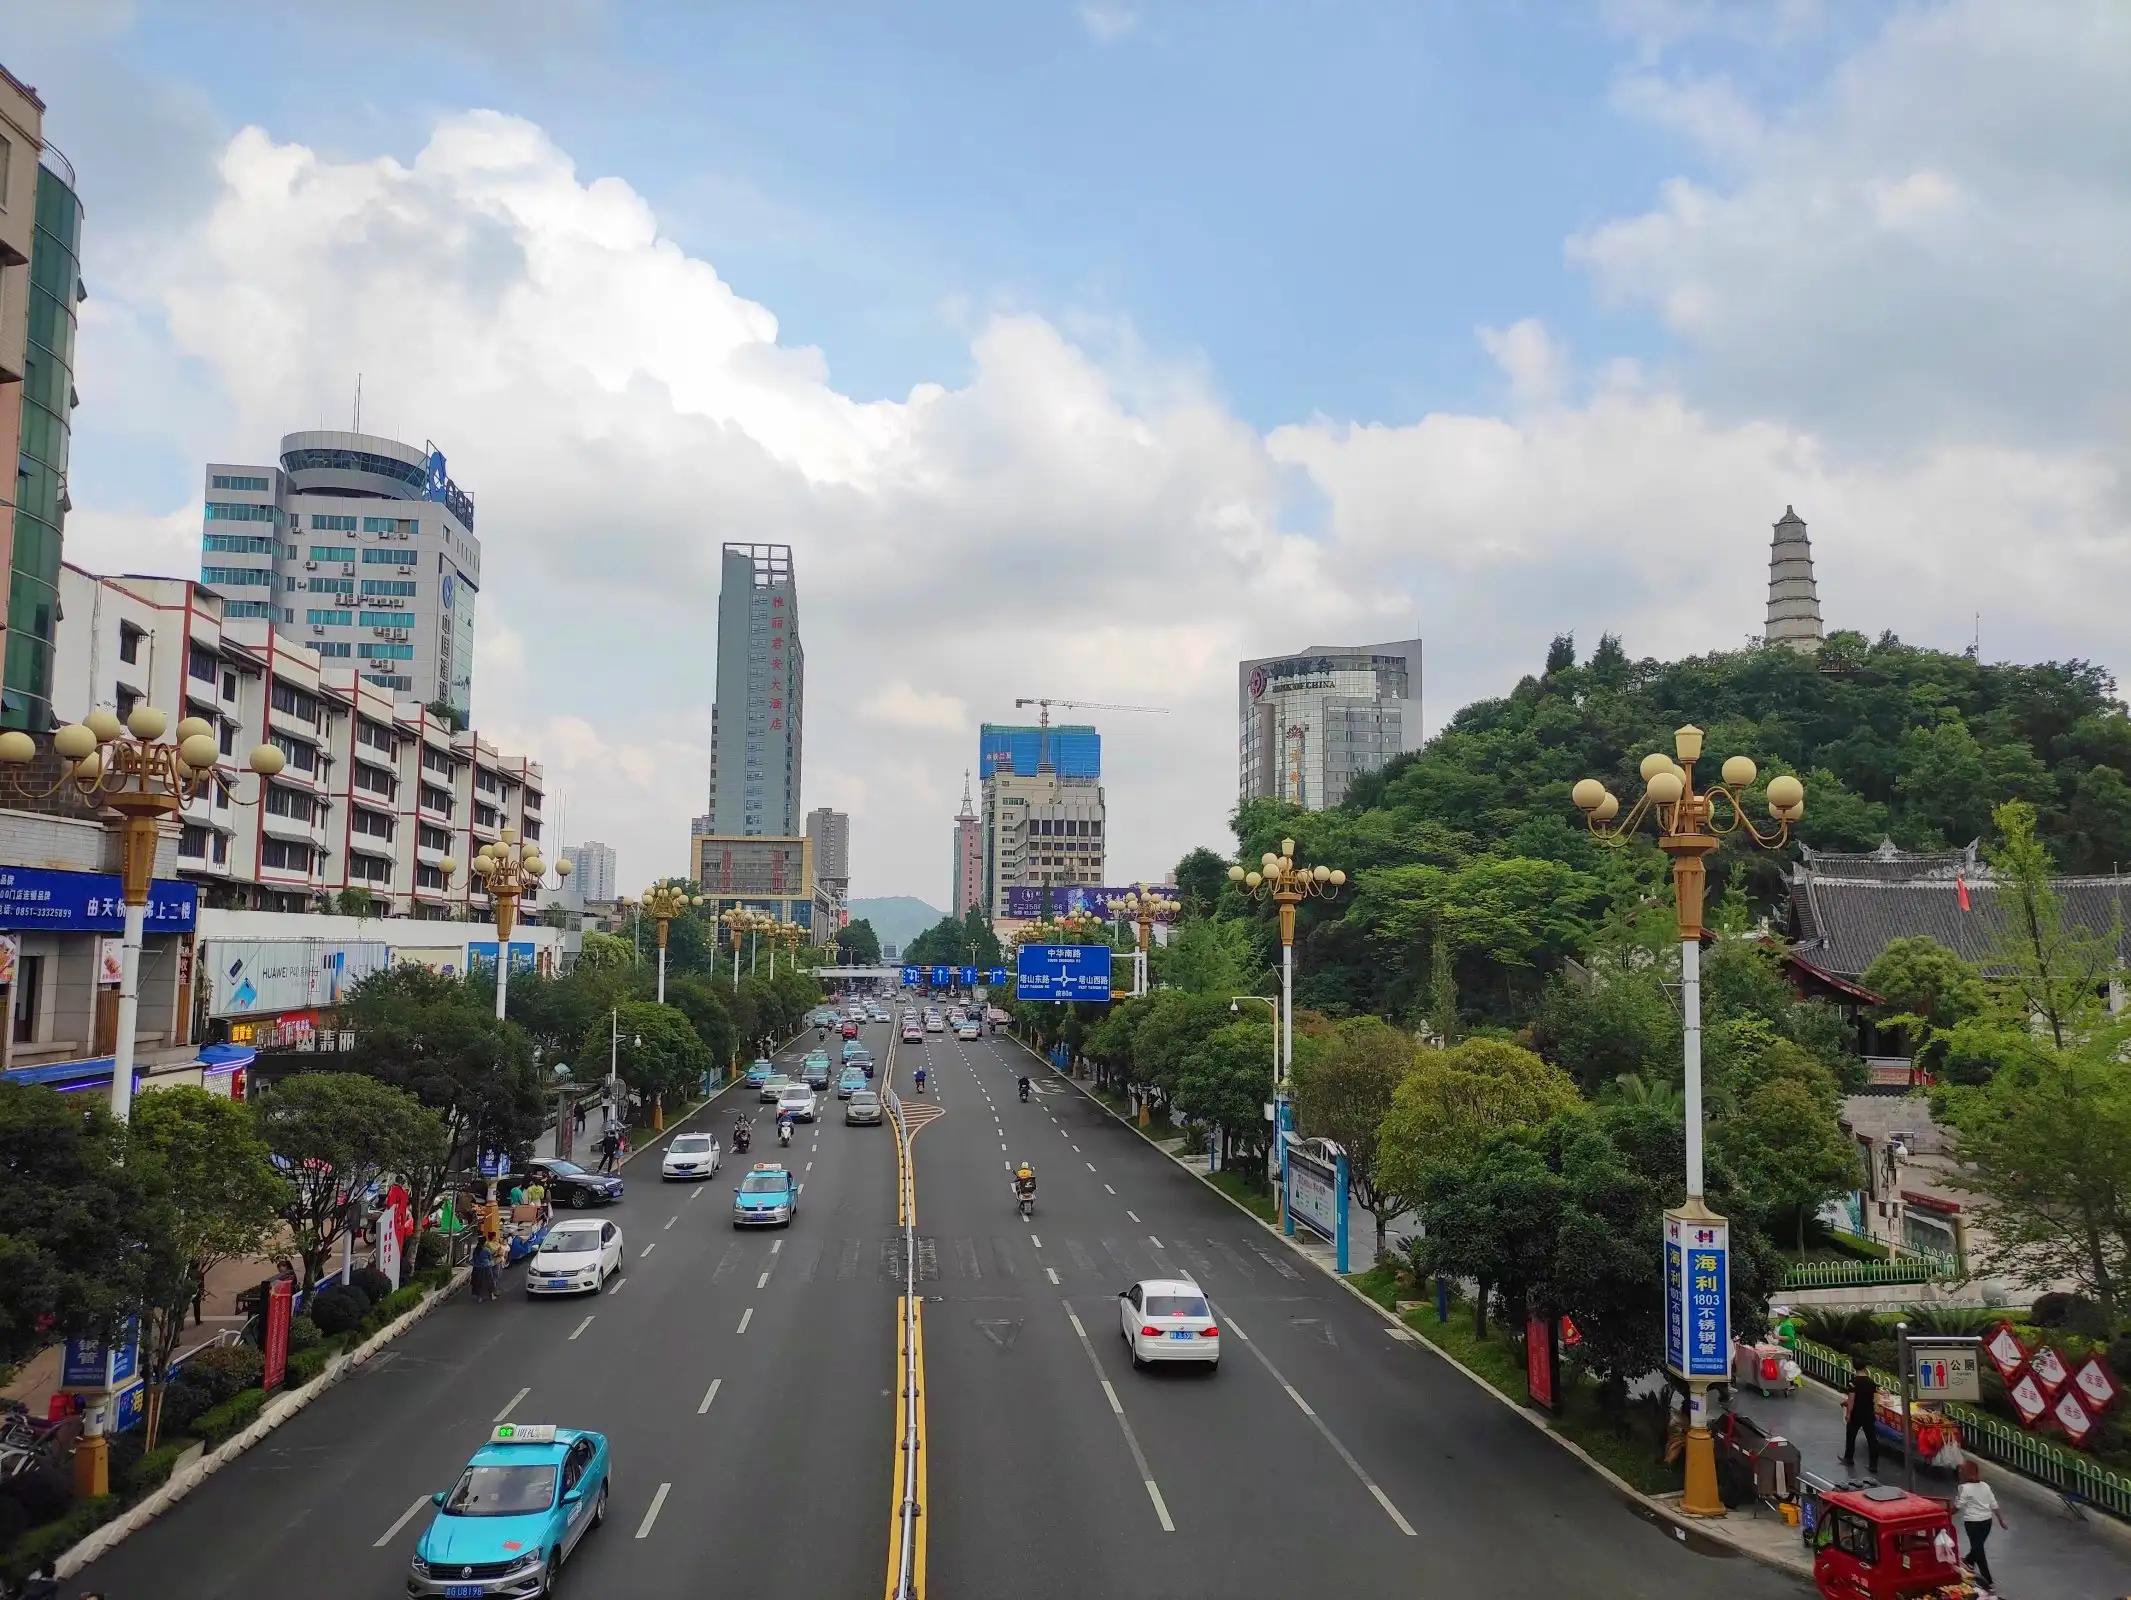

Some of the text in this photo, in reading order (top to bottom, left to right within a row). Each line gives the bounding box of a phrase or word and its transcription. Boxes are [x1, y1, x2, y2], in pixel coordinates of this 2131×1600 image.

[1305, 681, 1335, 689] CHINA
[1048, 949, 1081, 958] 中华南路
[263, 967, 288, 979] HUAWEI
[1020, 975, 1108, 985] 塔山东路 塔山西路
